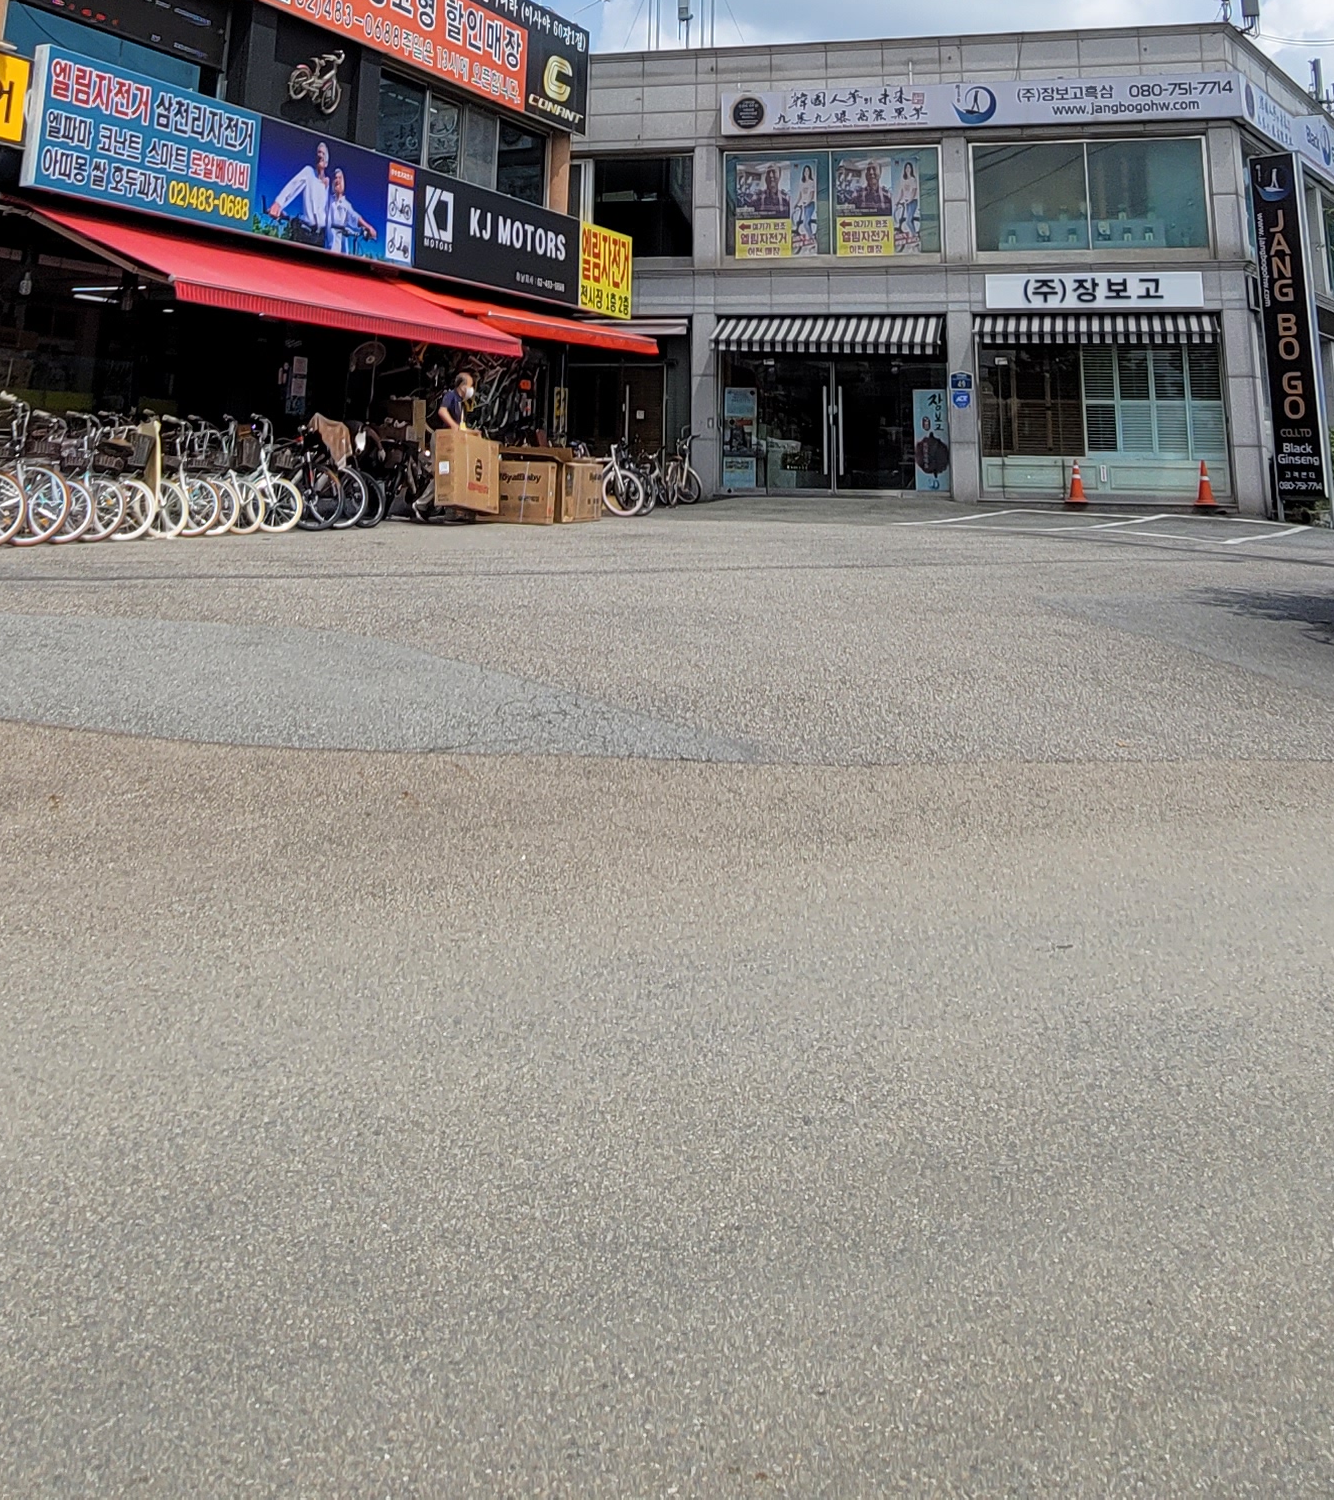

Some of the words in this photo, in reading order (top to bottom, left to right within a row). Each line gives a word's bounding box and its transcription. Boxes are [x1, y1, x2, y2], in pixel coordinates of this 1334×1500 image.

[52, 58, 152, 125] 엘림자전거
[155, 92, 255, 156] 삼천리자전거
[1017, 84, 1114, 102] (주)장보고흑삼
[1128, 80, 1234, 99] 080-751-7714
[1051, 100, 1200, 116] www.jangbogohw.com
[528, 94, 584, 124] CONANT
[47, 109, 93, 149] 엘파마
[98, 123, 142, 162] 코난트
[146, 138, 188, 175] 스마트
[189, 148, 250, 191] 로얄베이비
[91, 158, 108, 190] 쌀
[109, 163, 165, 204] 호두과자
[168, 180, 249, 220] 02)483-0688
[470, 206, 492, 248] KJ
[498, 217, 566, 261] MOTORS
[741, 232, 787, 245] 엘림자전거
[841, 230, 890, 244] 엘림자전거
[581, 226, 629, 291] 엘림자전거
[1269, 209, 1295, 302] JANG
[581, 285, 603, 310] 전시장
[606, 292, 617, 312] 1층
[1023, 277, 1164, 304] (주)장보고
[1277, 313, 1300, 361] BO
[928, 393, 944, 431] 장보고
[1282, 371, 1306, 420] GO
[1277, 453, 1320, 466] Ginseng
[1283, 442, 1313, 454] Black
